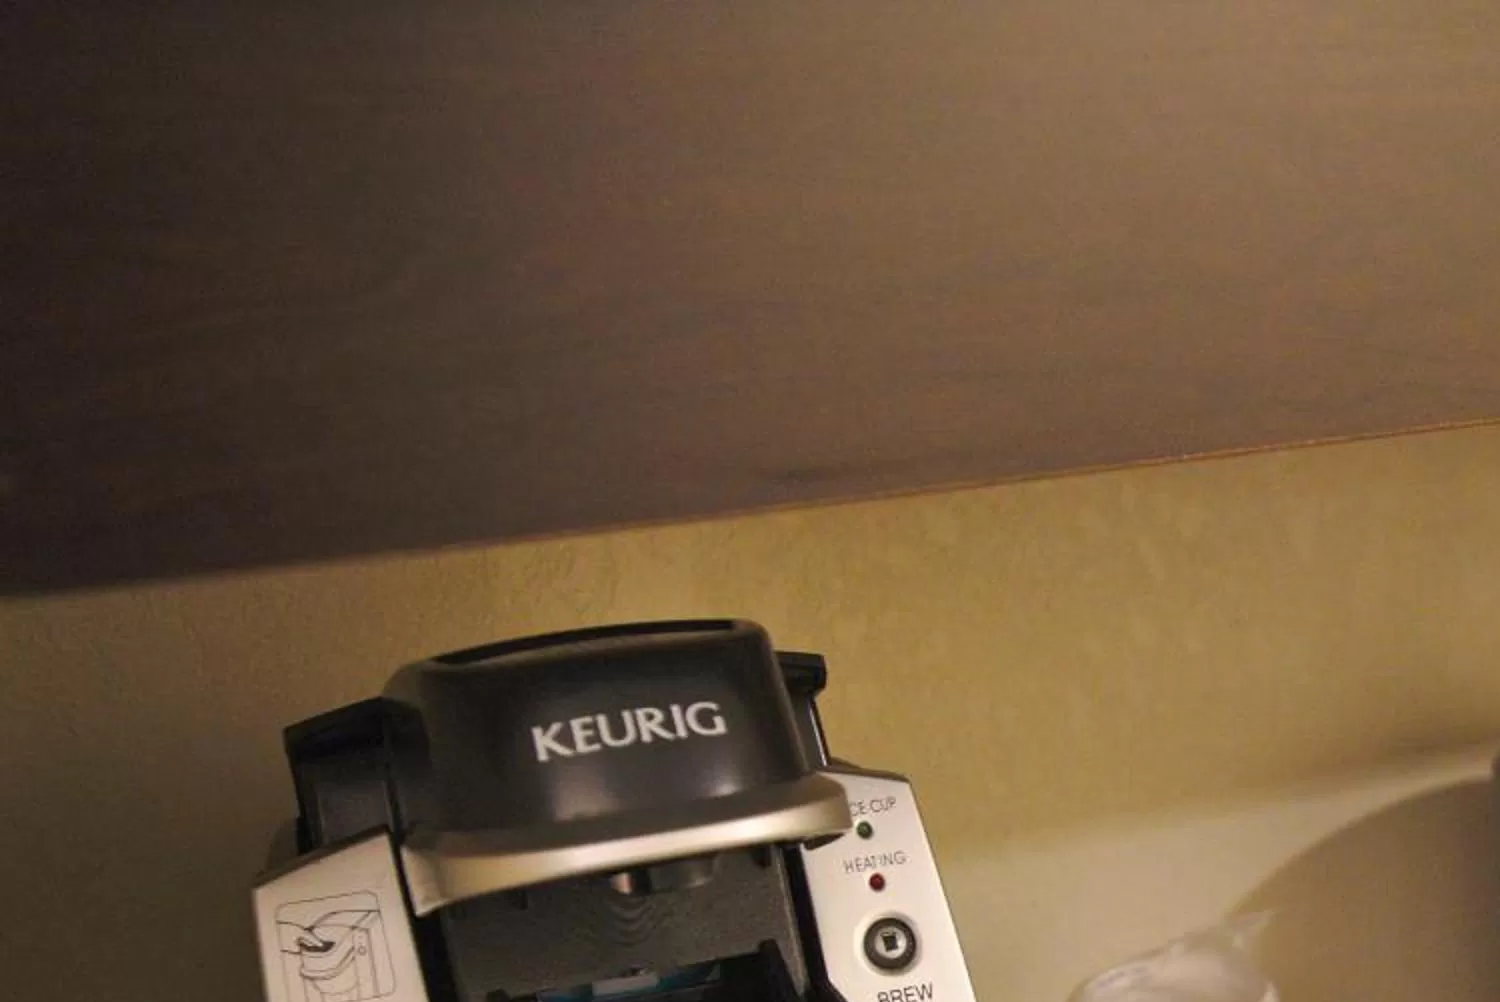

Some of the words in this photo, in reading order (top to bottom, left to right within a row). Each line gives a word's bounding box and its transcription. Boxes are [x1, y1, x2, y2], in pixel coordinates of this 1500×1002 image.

[530, 701, 728, 763] KEURIG
[870, 796, 897, 813] CUP
[844, 850, 907, 873] HEATING
